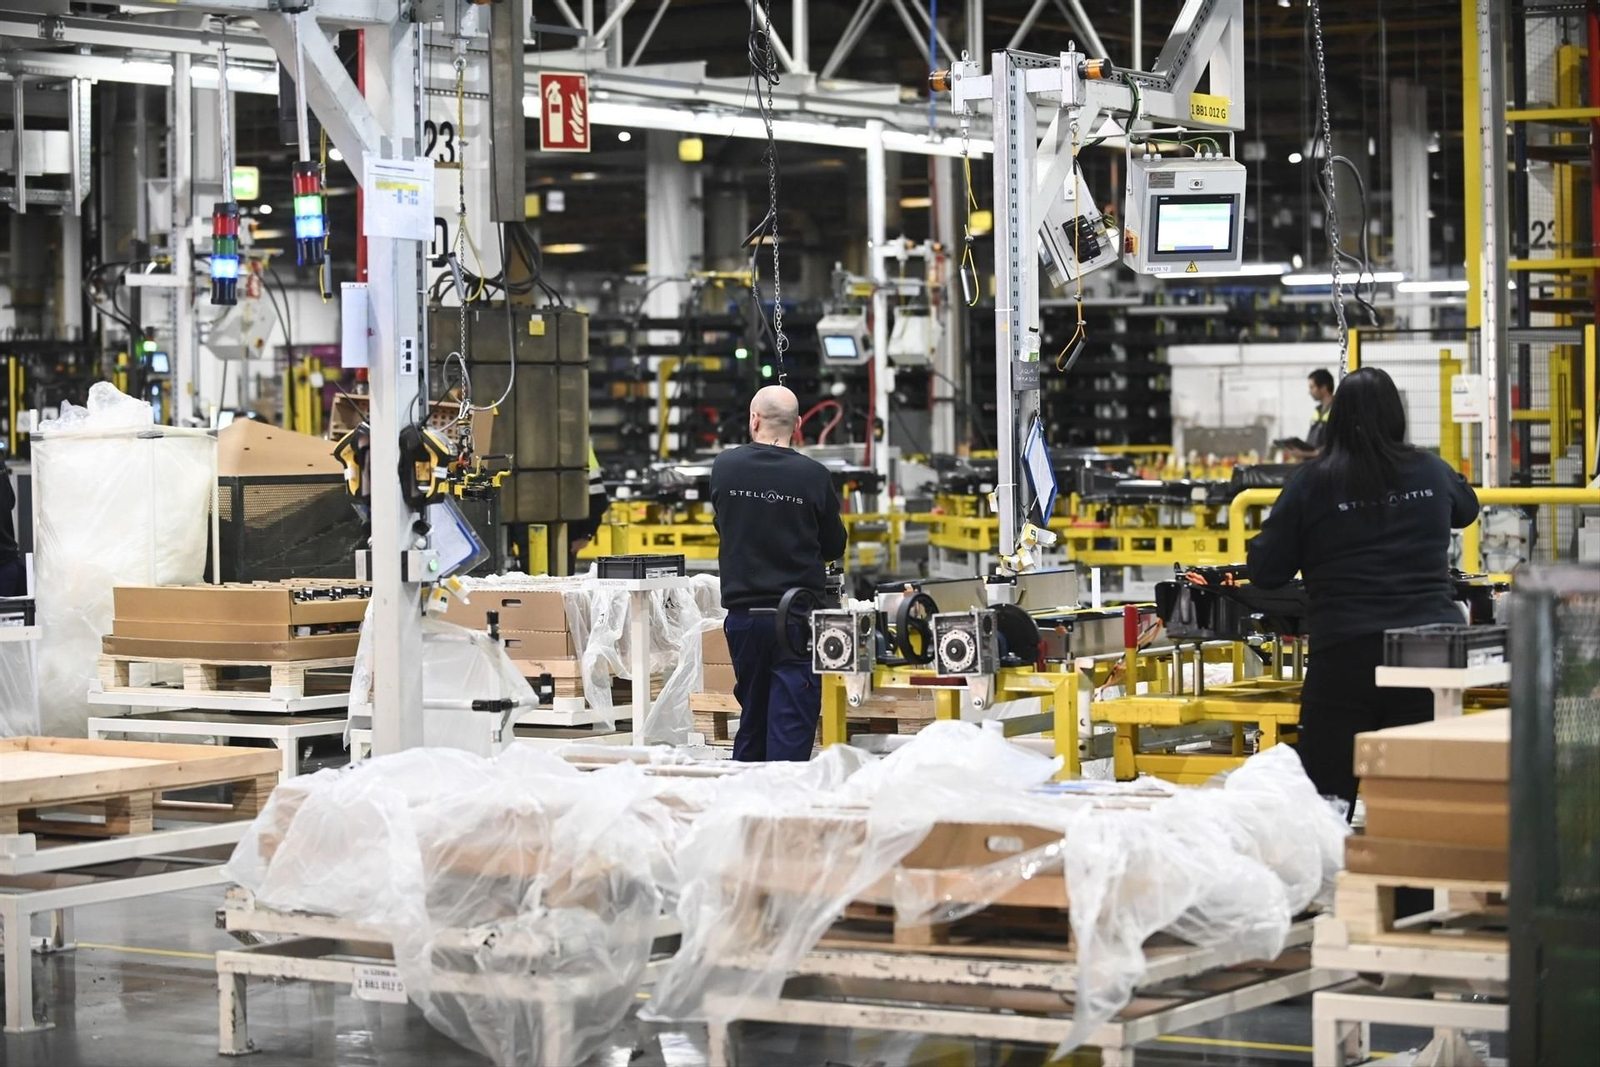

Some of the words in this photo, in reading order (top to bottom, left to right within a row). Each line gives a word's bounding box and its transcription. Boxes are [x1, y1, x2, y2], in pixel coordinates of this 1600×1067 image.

[1191, 103, 1195, 115] 1
[1208, 106, 1220, 119] 012
[1221, 108, 1227, 120] G
[424, 120, 455, 163] 23
[729, 489, 804, 505] STELLANTIS
[1193, 539, 1206, 552] 16
